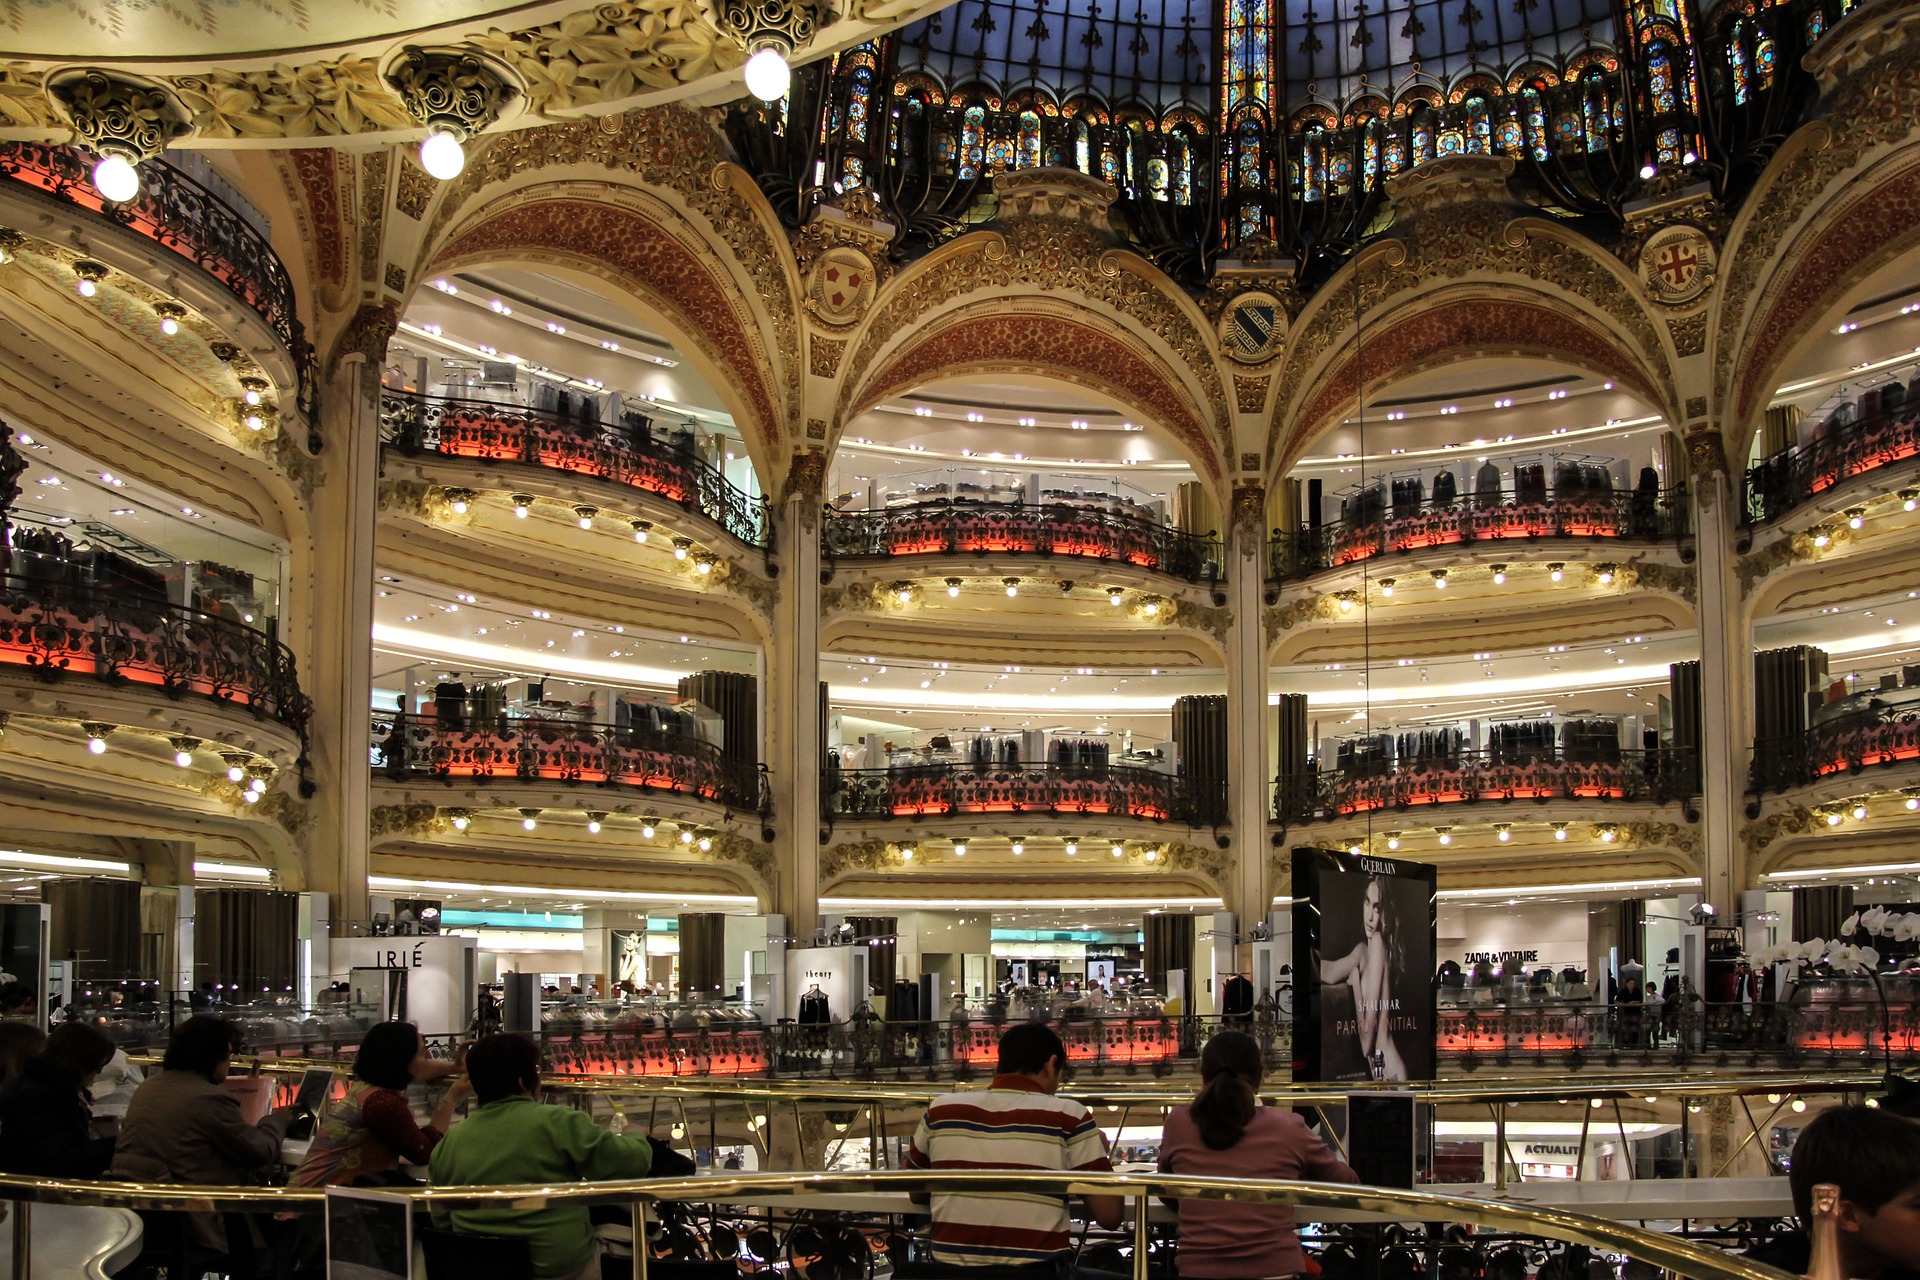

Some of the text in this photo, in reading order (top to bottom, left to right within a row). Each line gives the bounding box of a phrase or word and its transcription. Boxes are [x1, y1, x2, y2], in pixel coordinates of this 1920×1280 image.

[1360, 857, 1396, 875] GUERLAIN
[377, 941, 427, 968] IRIÉ
[805, 970, 832, 979] theory
[1358, 999, 1401, 1012] SHALIMAR
[1524, 1144, 1580, 1155] ACTUALIT
